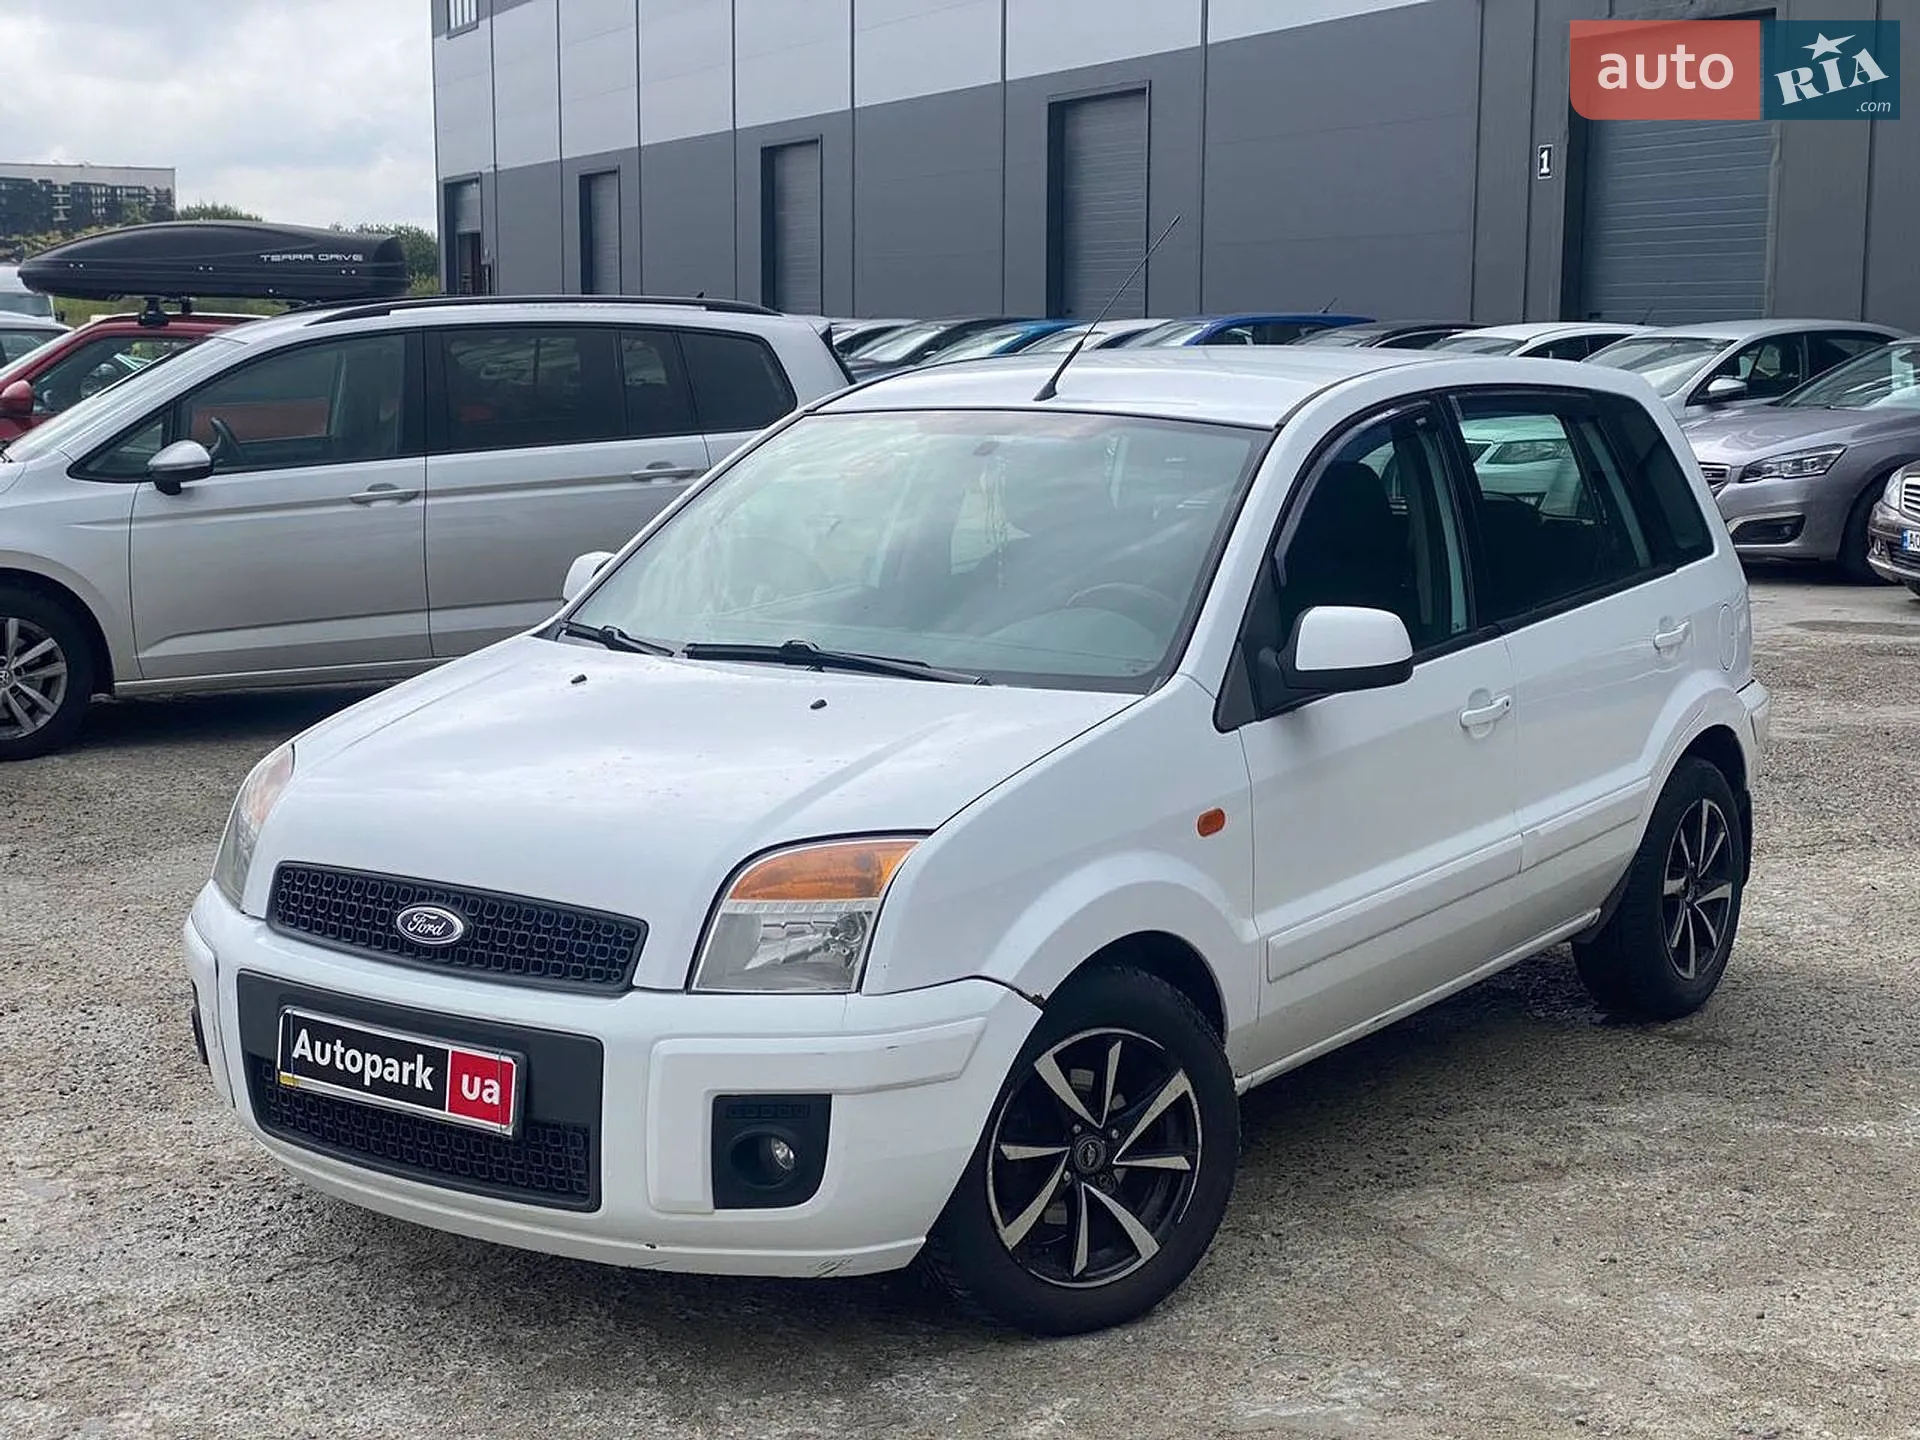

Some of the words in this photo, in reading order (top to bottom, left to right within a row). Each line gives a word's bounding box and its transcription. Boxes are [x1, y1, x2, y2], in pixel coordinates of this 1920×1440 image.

[1540, 150, 1550, 173] 1
[260, 253, 314, 262] TERRA
[318, 253, 363, 262] DRIVE
[407, 912, 447, 936] Ford
[292, 1028, 434, 1092] Autopark
[461, 1073, 501, 1105] ua
